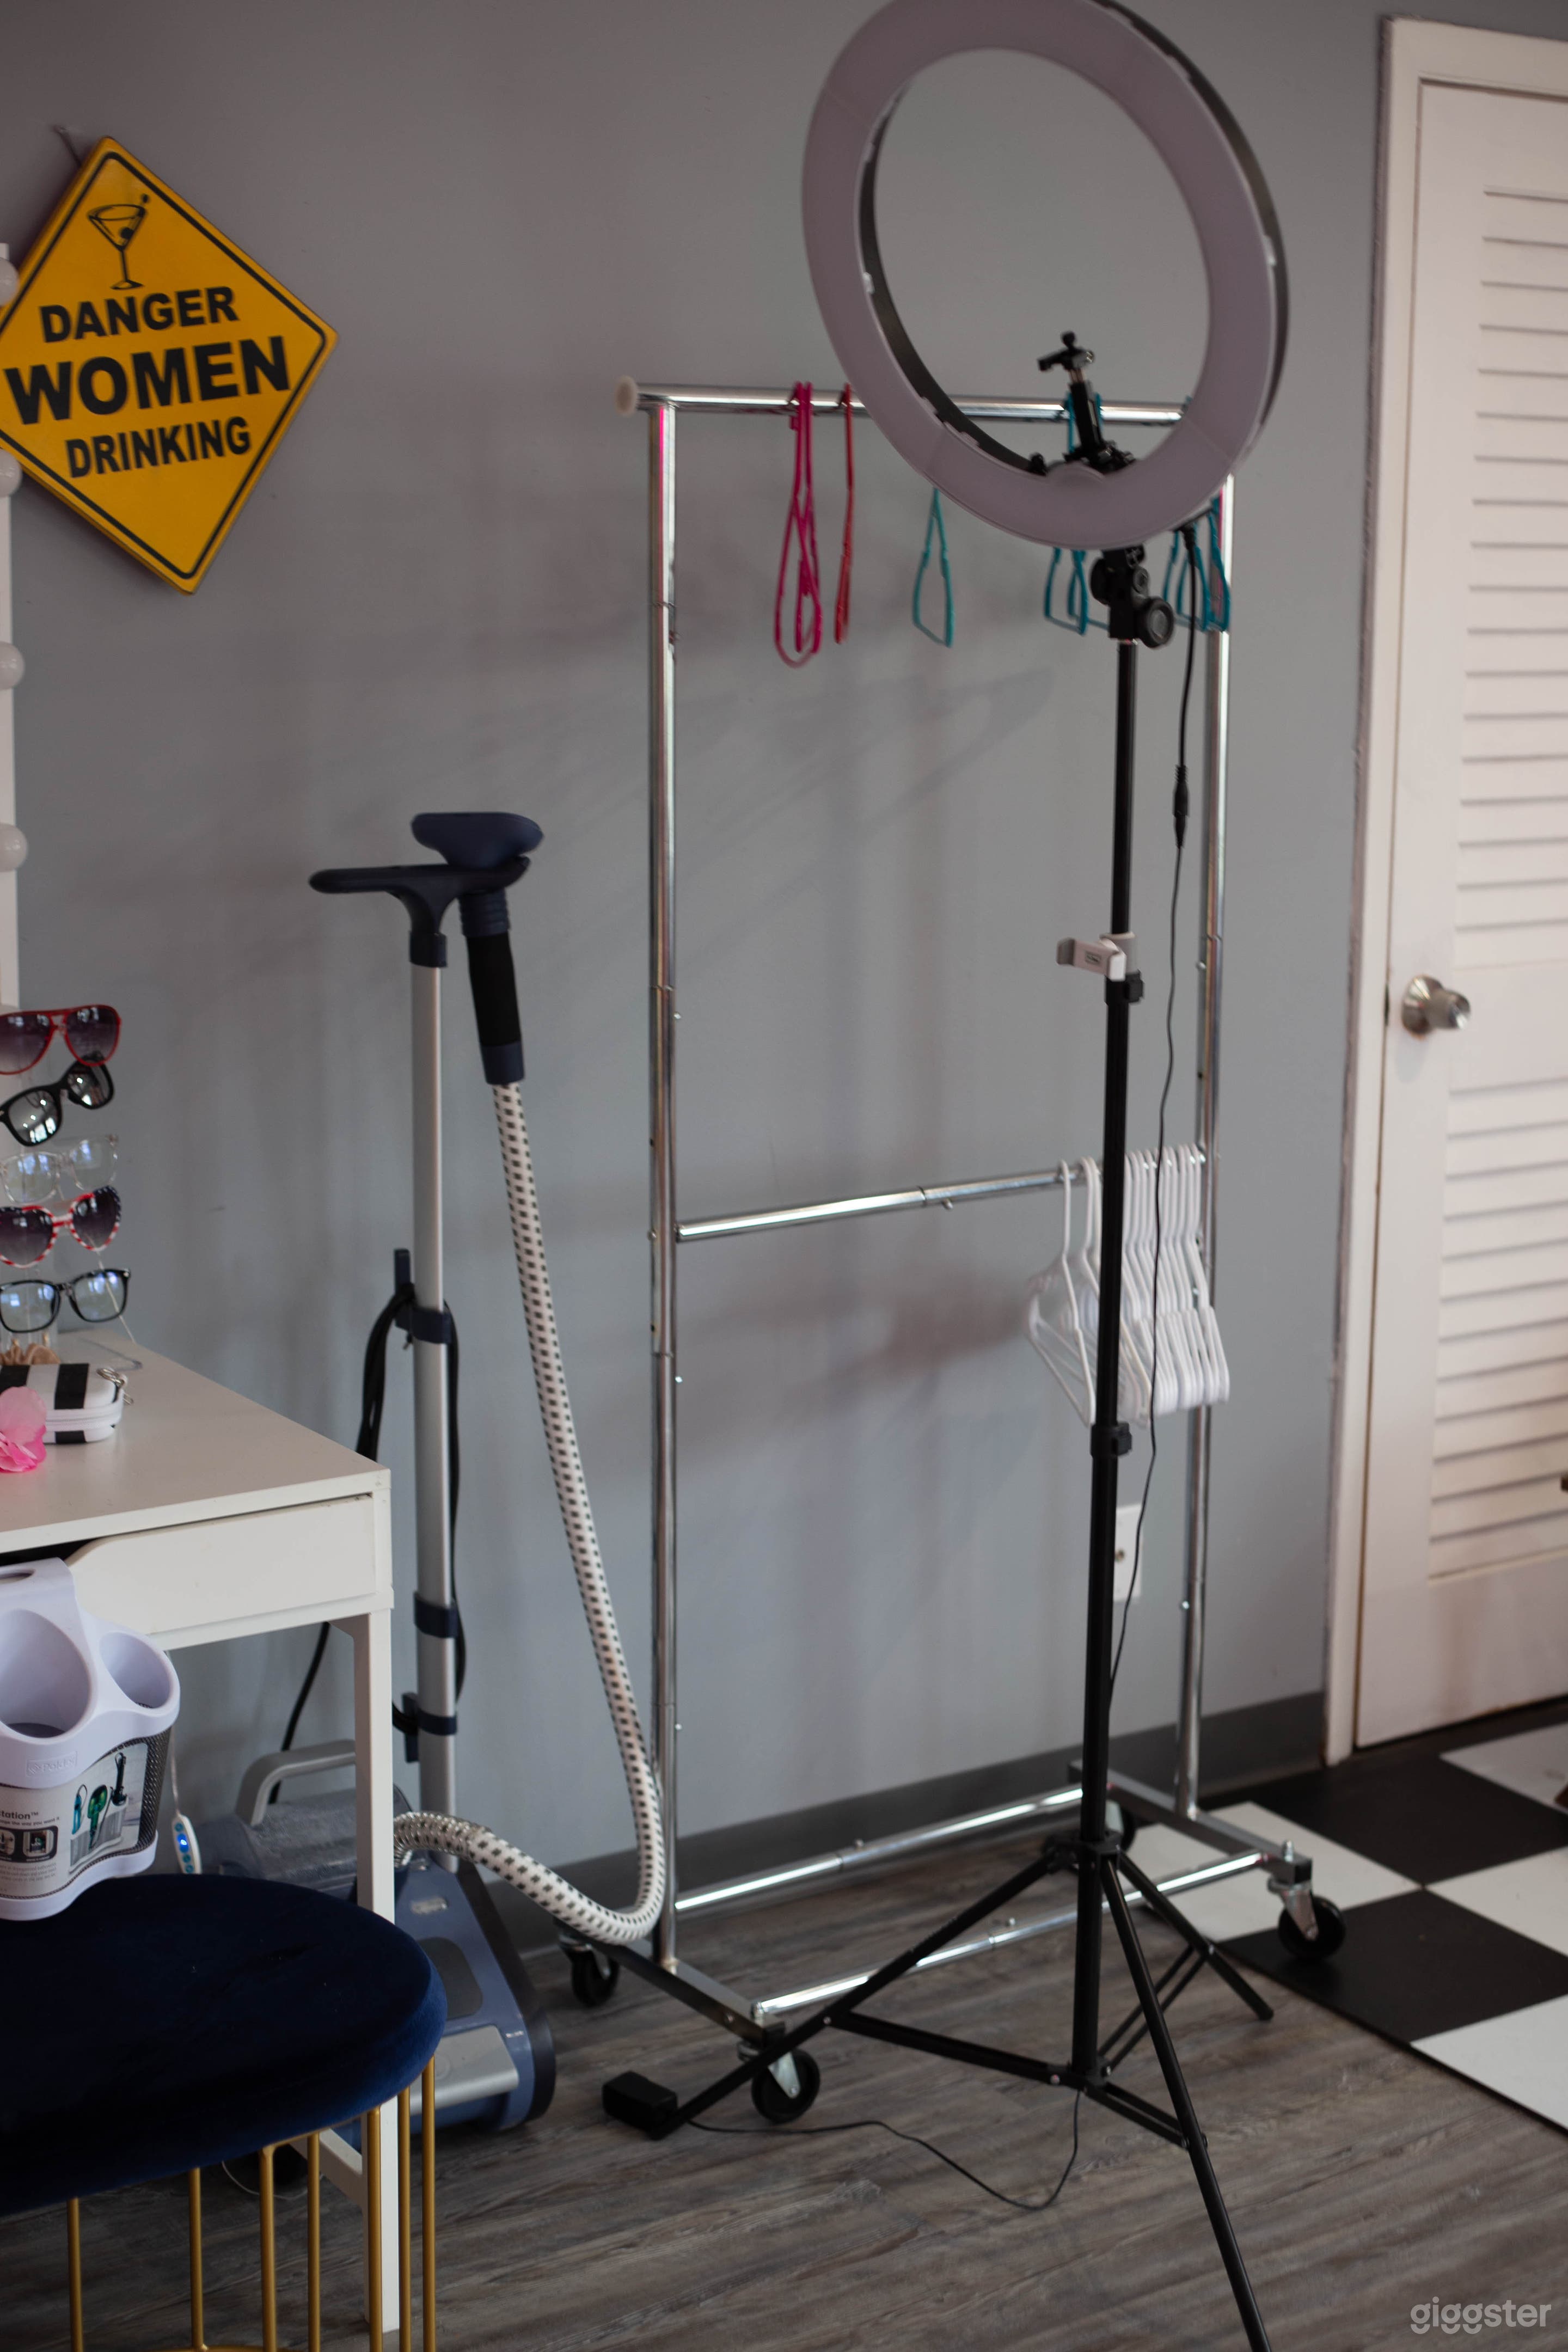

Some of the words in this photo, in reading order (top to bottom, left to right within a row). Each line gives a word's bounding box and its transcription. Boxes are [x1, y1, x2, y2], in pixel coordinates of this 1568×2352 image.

[39, 286, 238, 343] DANGER
[3, 335, 291, 426] WOMEN
[65, 416, 250, 478] DRINKING
